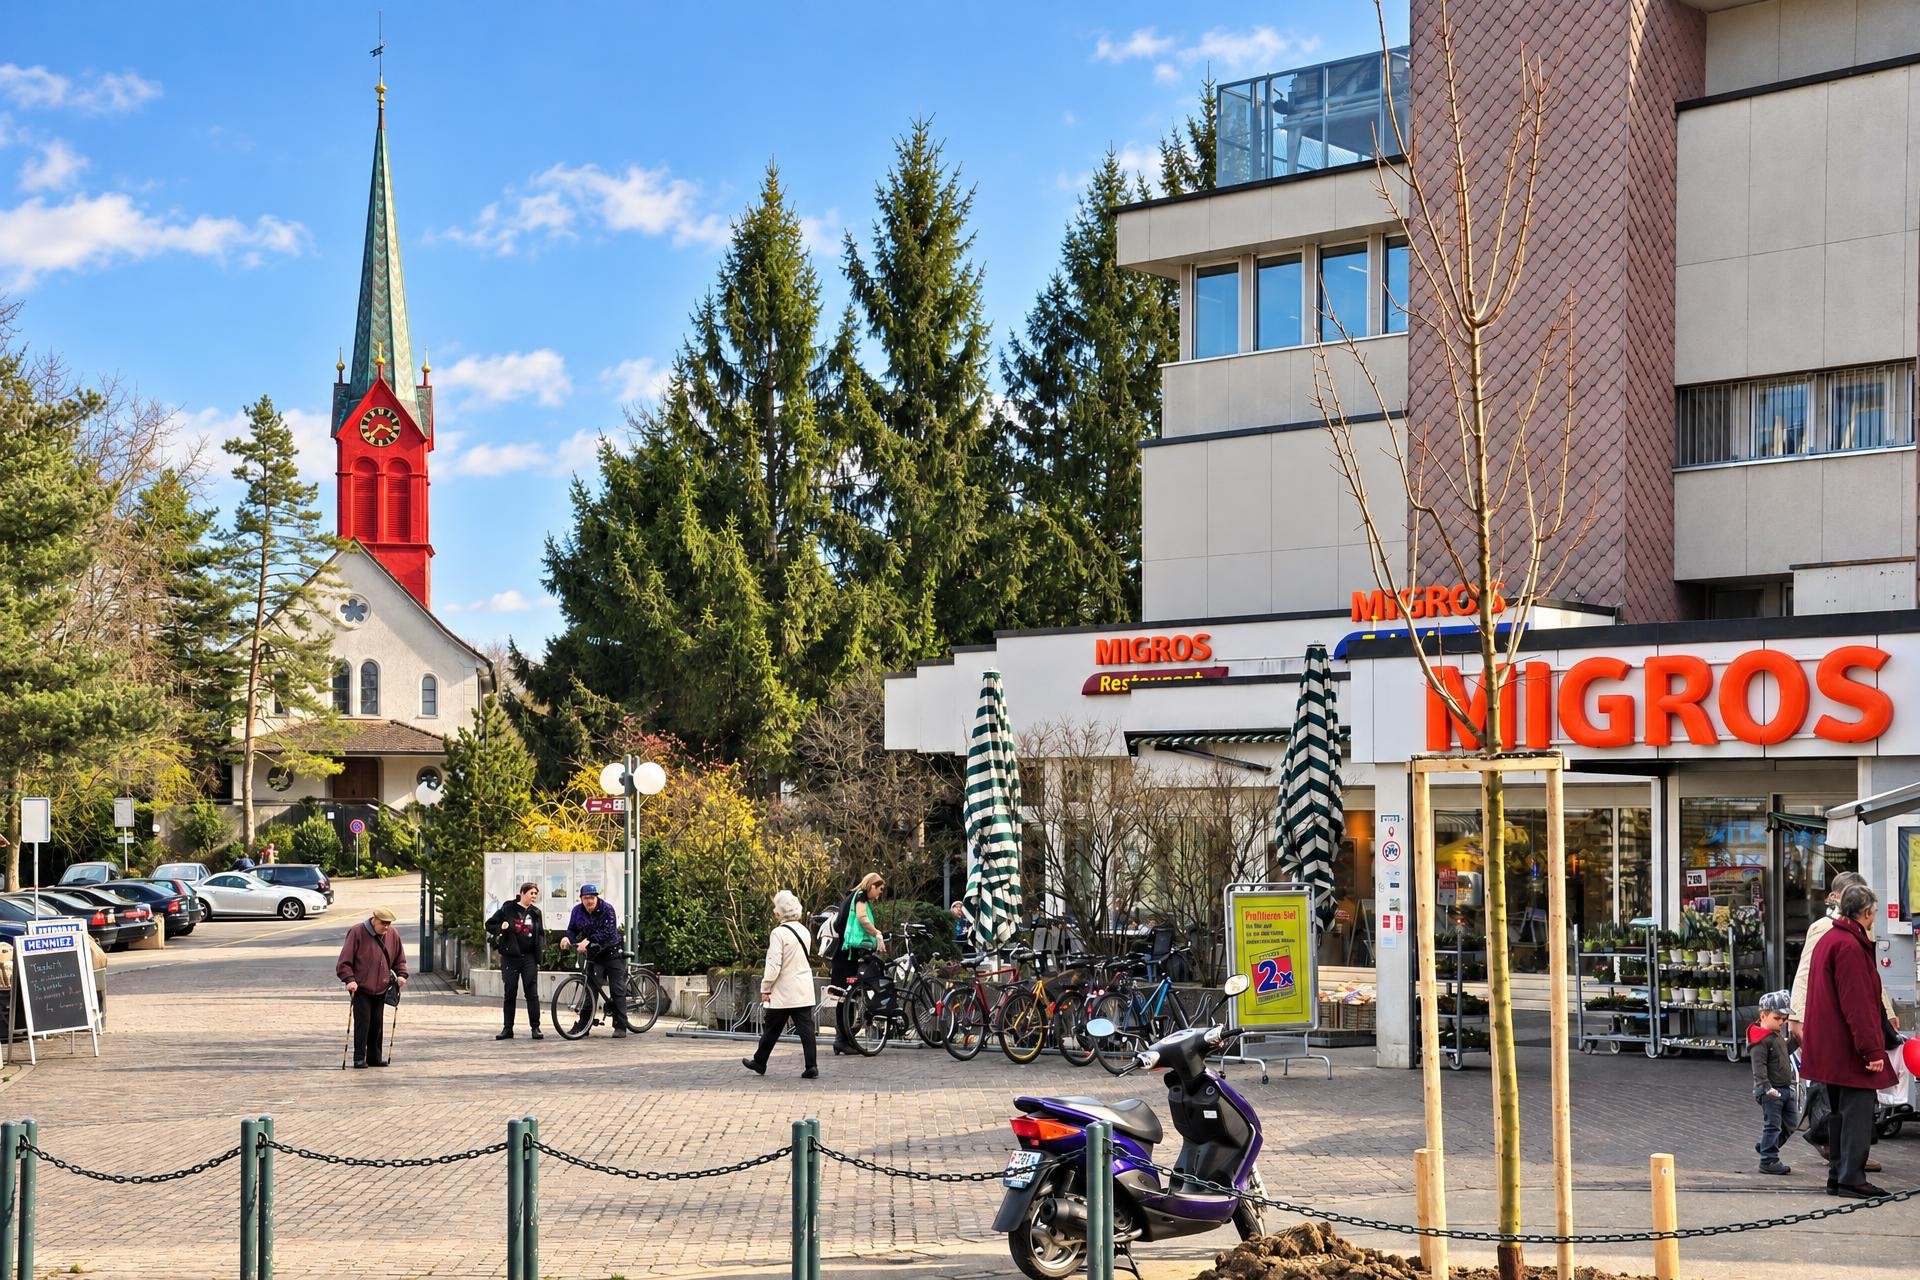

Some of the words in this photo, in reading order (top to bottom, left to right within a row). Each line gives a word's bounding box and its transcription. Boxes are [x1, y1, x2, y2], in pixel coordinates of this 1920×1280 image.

[1351, 580, 1507, 622] MIGROS
[1095, 633, 1213, 666] MIGROS
[1425, 645, 1894, 752] MIGROS
[28, 938, 72, 950] HENNIEZ
[1258, 960, 1294, 993] 2x
